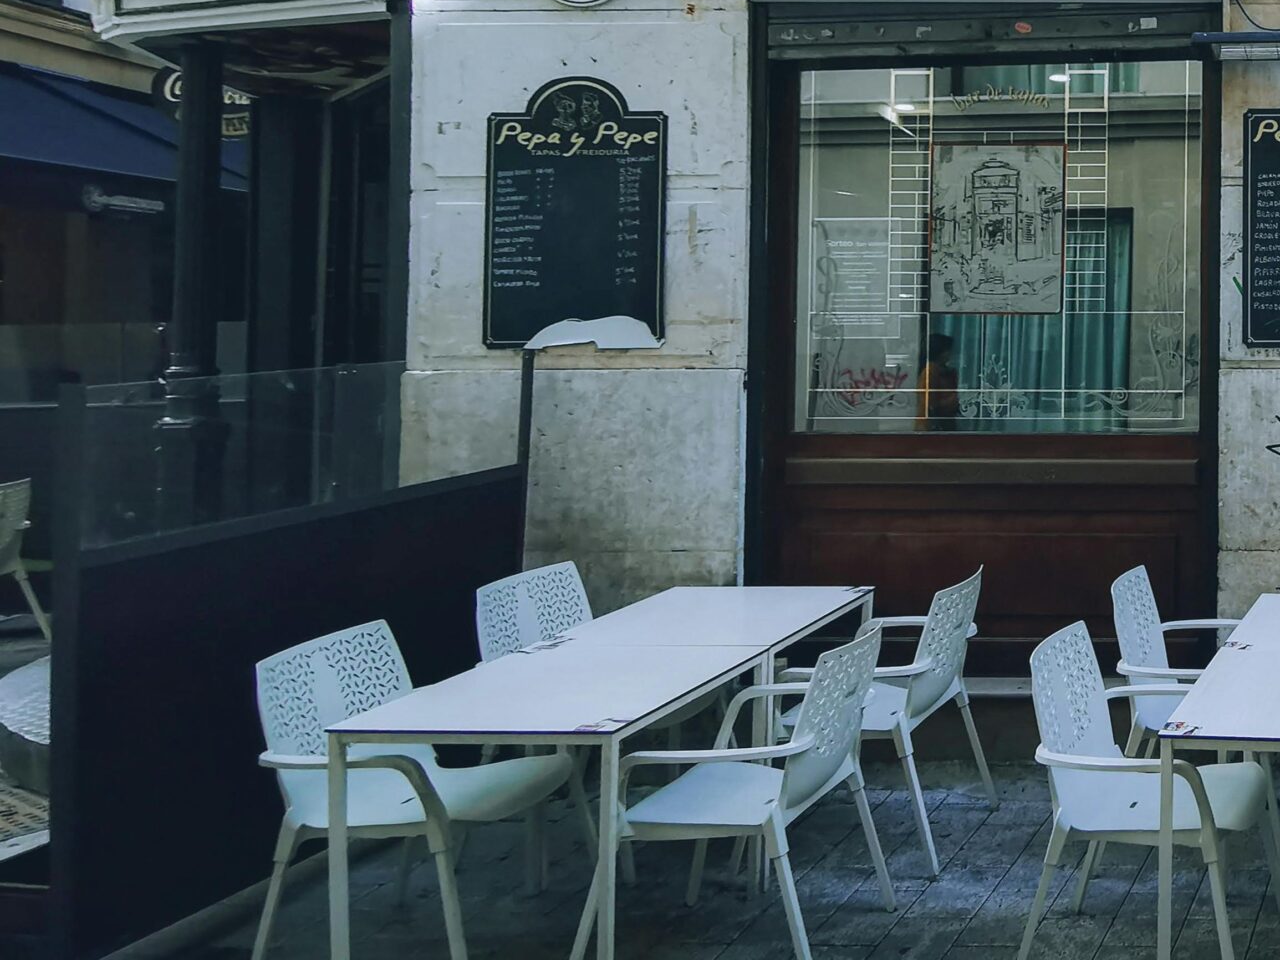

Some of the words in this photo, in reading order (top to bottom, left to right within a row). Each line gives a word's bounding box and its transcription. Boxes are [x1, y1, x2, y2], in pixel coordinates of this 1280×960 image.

[496, 121, 561, 150] Pepa
[562, 132, 585, 157] y
[593, 121, 658, 149] Pepe
